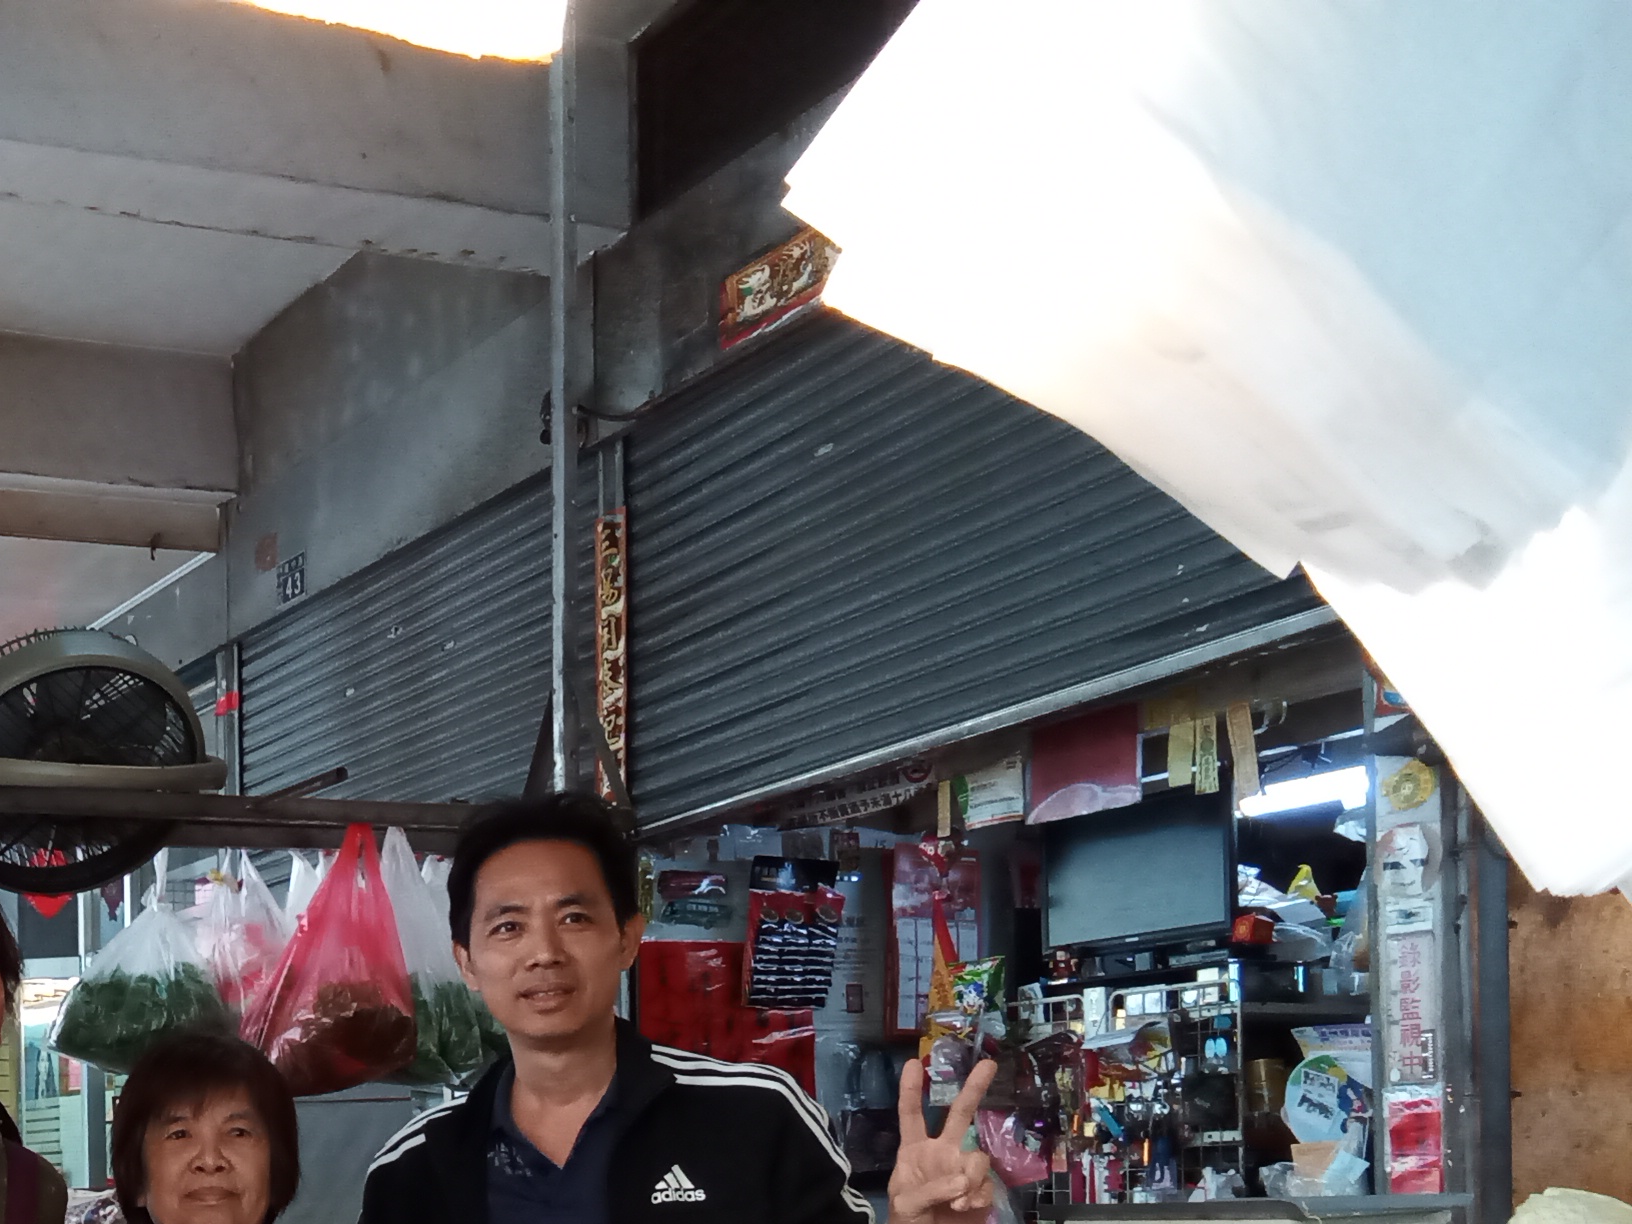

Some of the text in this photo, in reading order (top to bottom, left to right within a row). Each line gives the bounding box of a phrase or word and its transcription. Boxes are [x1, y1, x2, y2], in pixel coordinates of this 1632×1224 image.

[1398, 942, 1424, 1075] 錄影監視中
[651, 1187, 706, 1204] adidas
